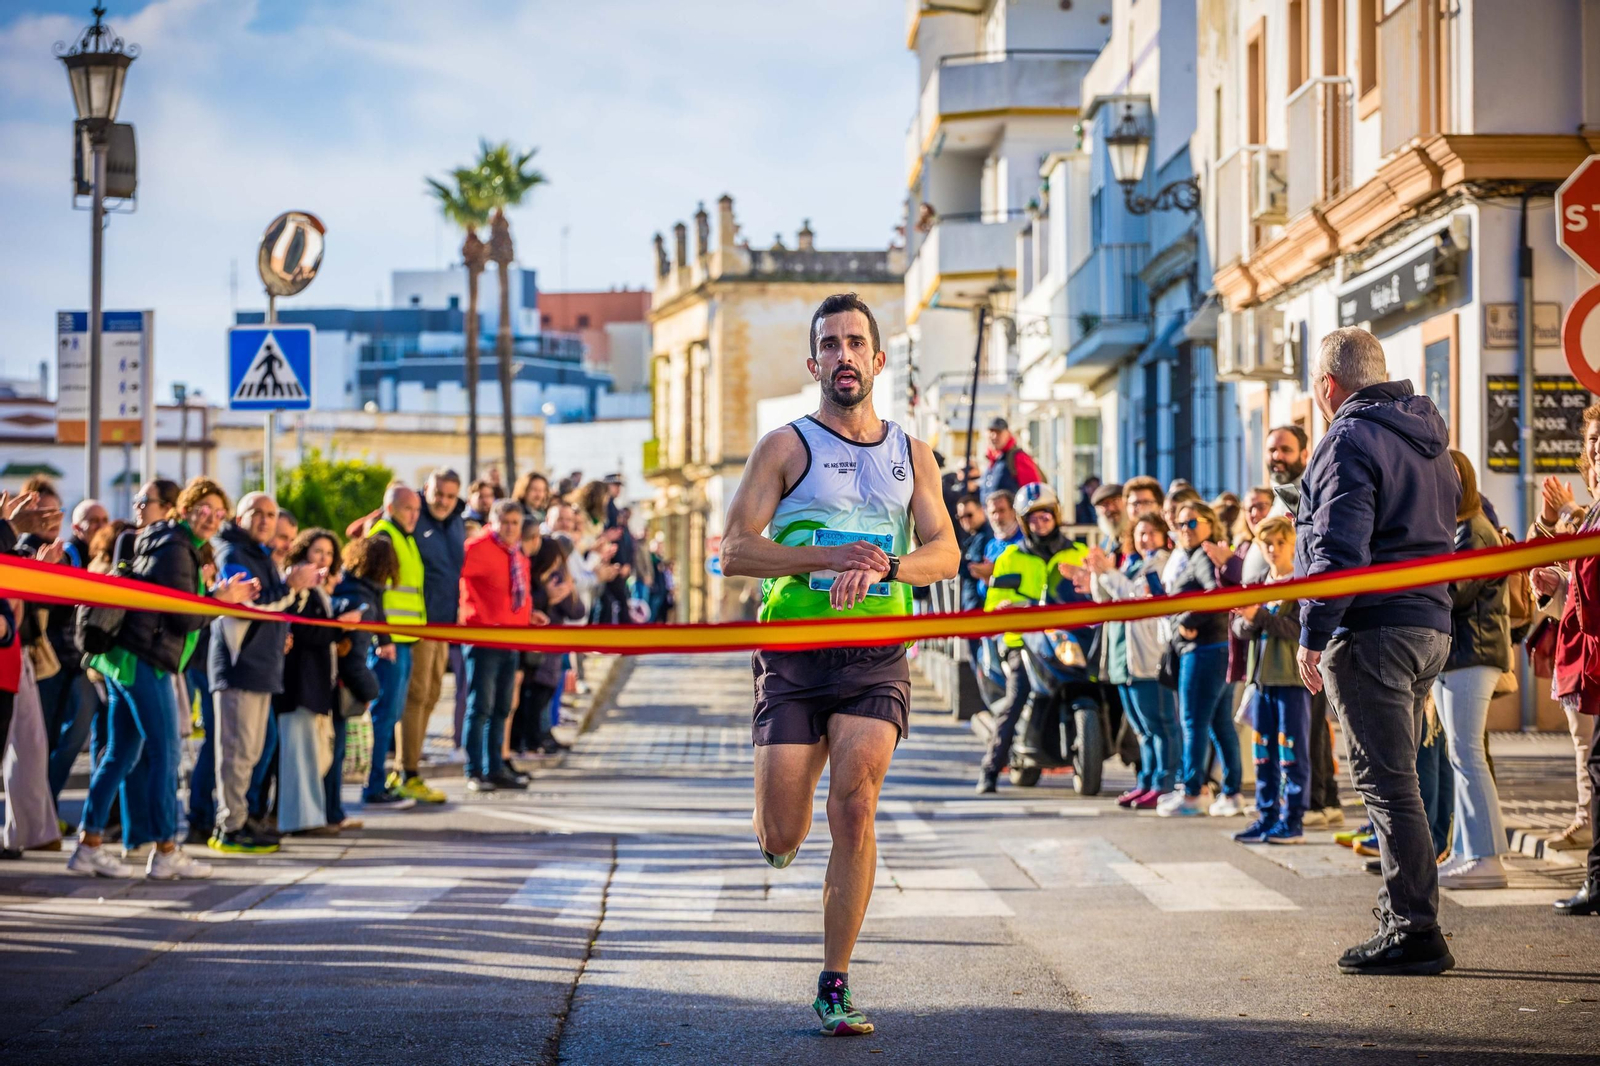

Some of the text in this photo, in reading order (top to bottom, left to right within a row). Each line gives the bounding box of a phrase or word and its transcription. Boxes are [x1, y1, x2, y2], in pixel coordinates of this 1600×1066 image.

[1493, 394, 1586, 408] VETA DE
[1512, 416, 1567, 431] NOS
[1492, 440, 1582, 454] A ANE
